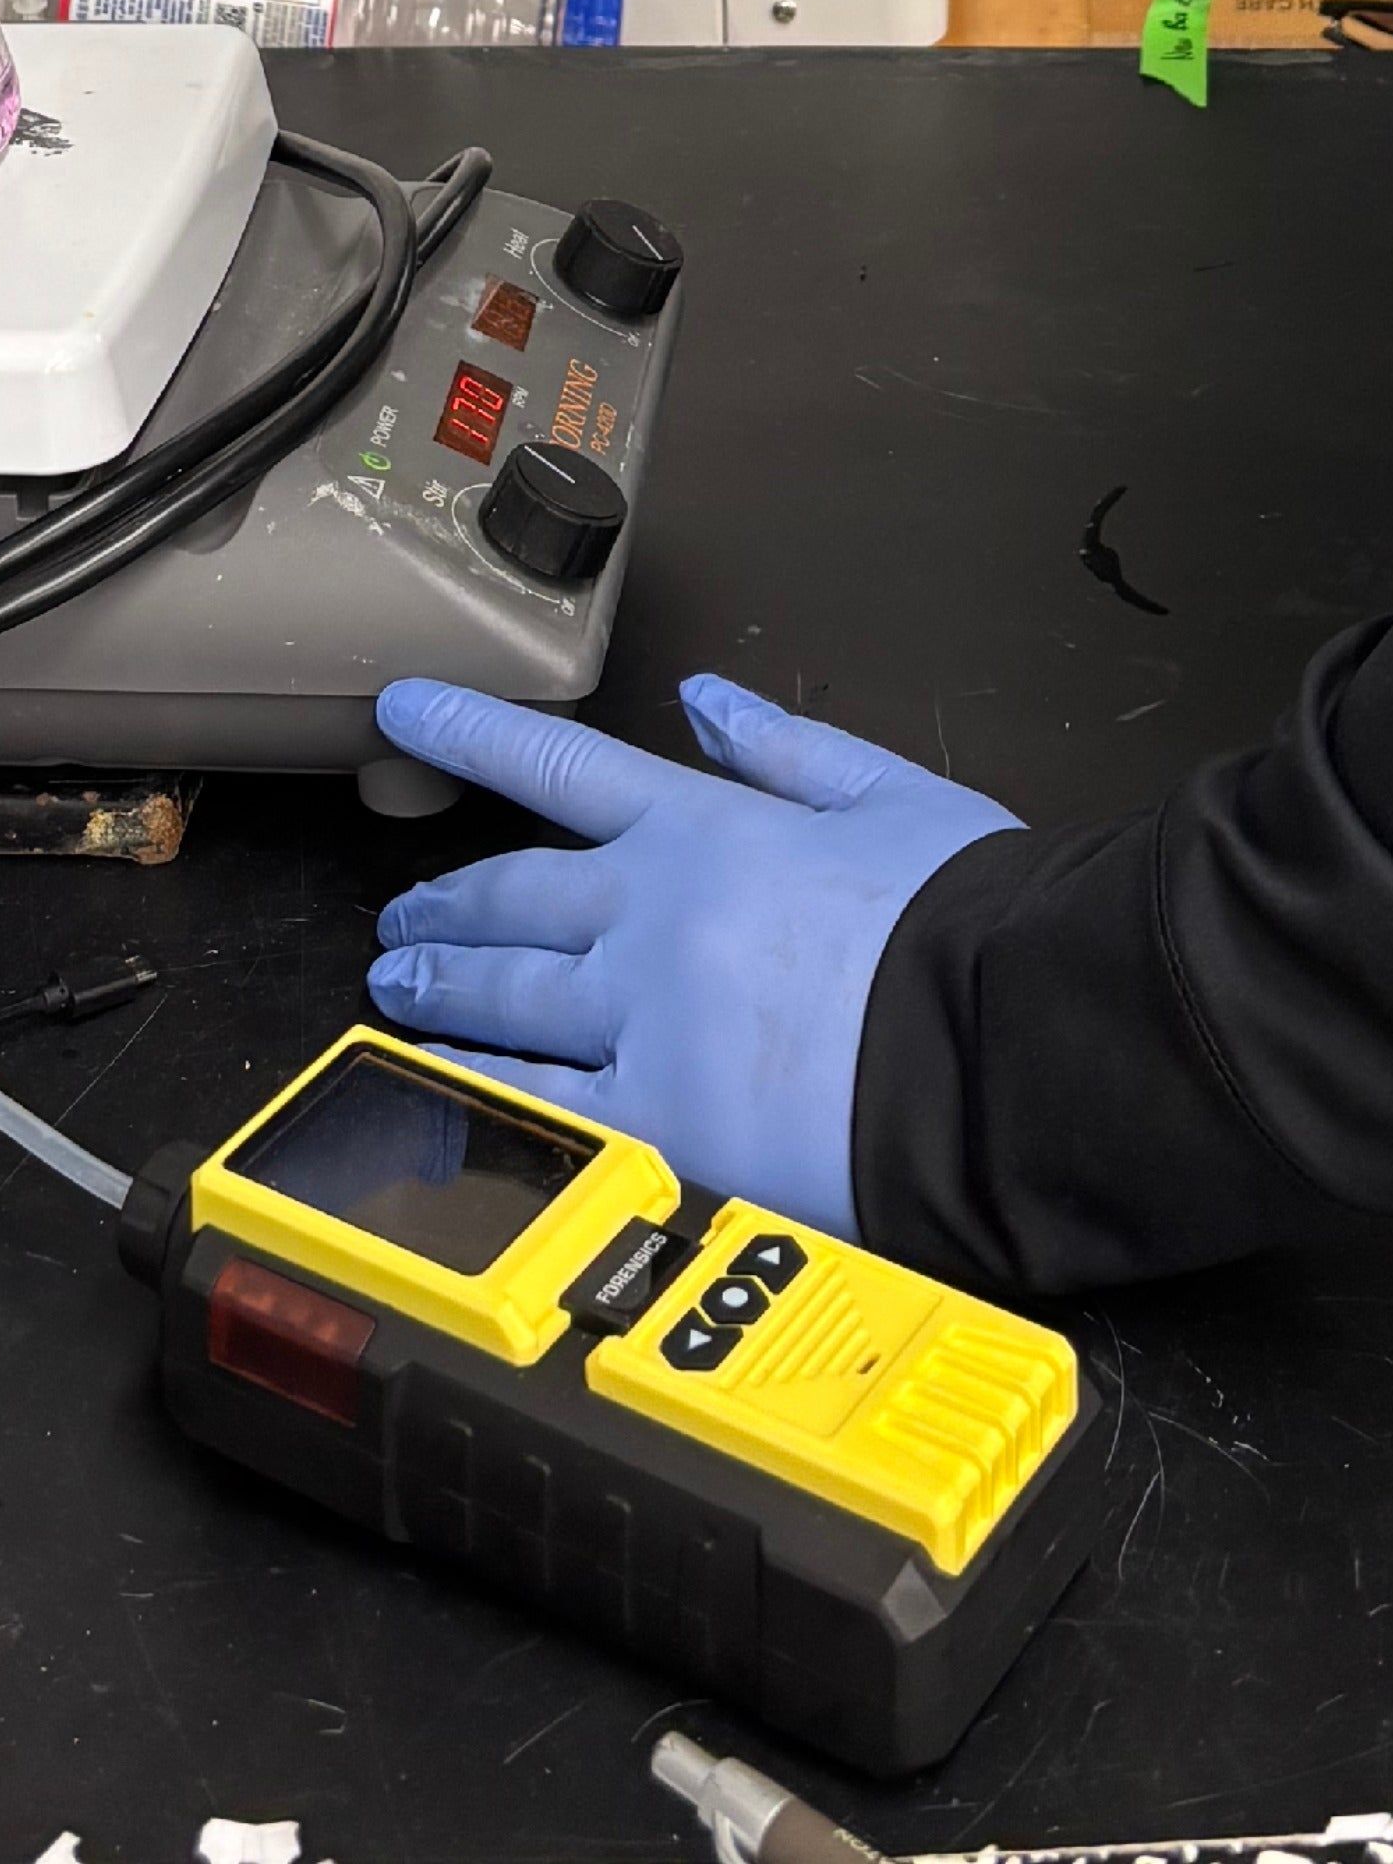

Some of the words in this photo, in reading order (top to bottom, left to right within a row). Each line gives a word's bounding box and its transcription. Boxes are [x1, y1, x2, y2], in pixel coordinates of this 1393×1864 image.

[503, 228, 529, 260] Heat
[451, 376, 503, 445] 170
[512, 386, 528, 408] RPM
[549, 359, 598, 450] ORNING
[370, 405, 399, 448] POWER
[422, 479, 448, 507] Stir
[595, 1232, 668, 1304] FORENSICS
